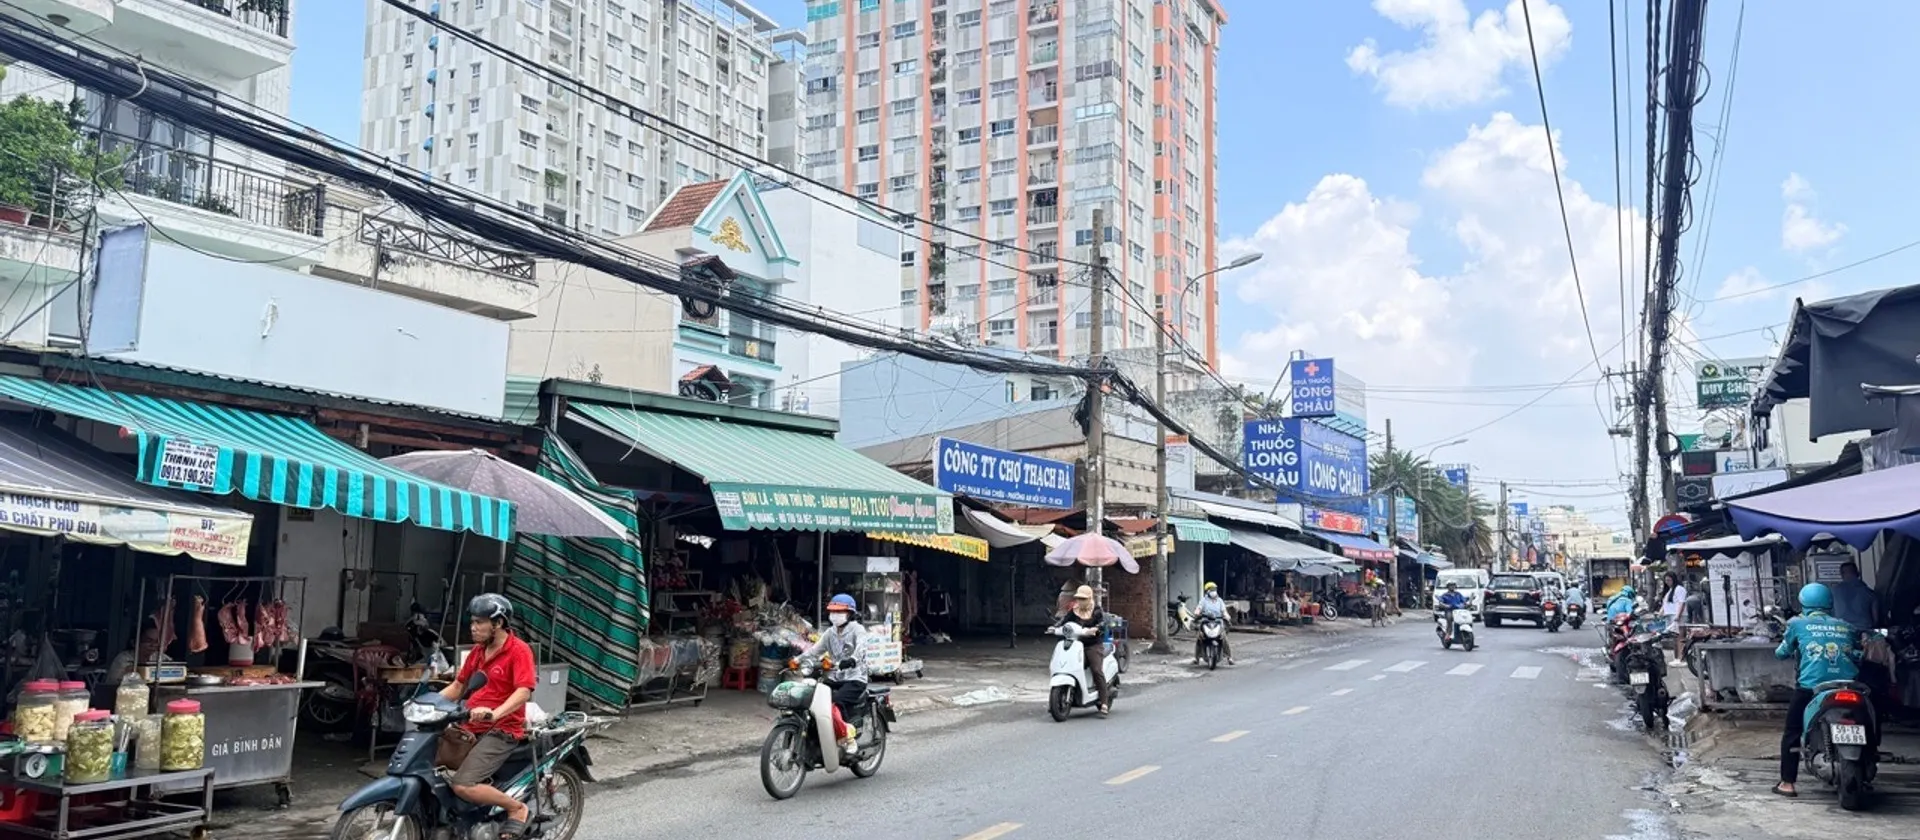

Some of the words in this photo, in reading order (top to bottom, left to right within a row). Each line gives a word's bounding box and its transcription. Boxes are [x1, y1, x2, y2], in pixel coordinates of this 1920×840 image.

[1293, 386, 1332, 398] LONG
[1293, 400, 1333, 413] CHÂU
[1258, 420, 1286, 434] NHÀ
[1251, 434, 1295, 451] THUỐC
[943, 443, 978, 476] CÔNG
[981, 454, 997, 479] TY
[999, 457, 1022, 489] CHỢ
[1023, 463, 1057, 492] THẠCH
[1248, 452, 1299, 467] LONG
[1309, 460, 1337, 491] LONG
[1339, 466, 1364, 496] CHÂU
[54, 498, 80, 513] CAO
[850, 496, 869, 516] HOA
[870, 495, 890, 517] TƯƠI
[12, 508, 45, 527] CHẤT
[77, 520, 98, 536] GIA
[212, 738, 229, 756] GIÁ
